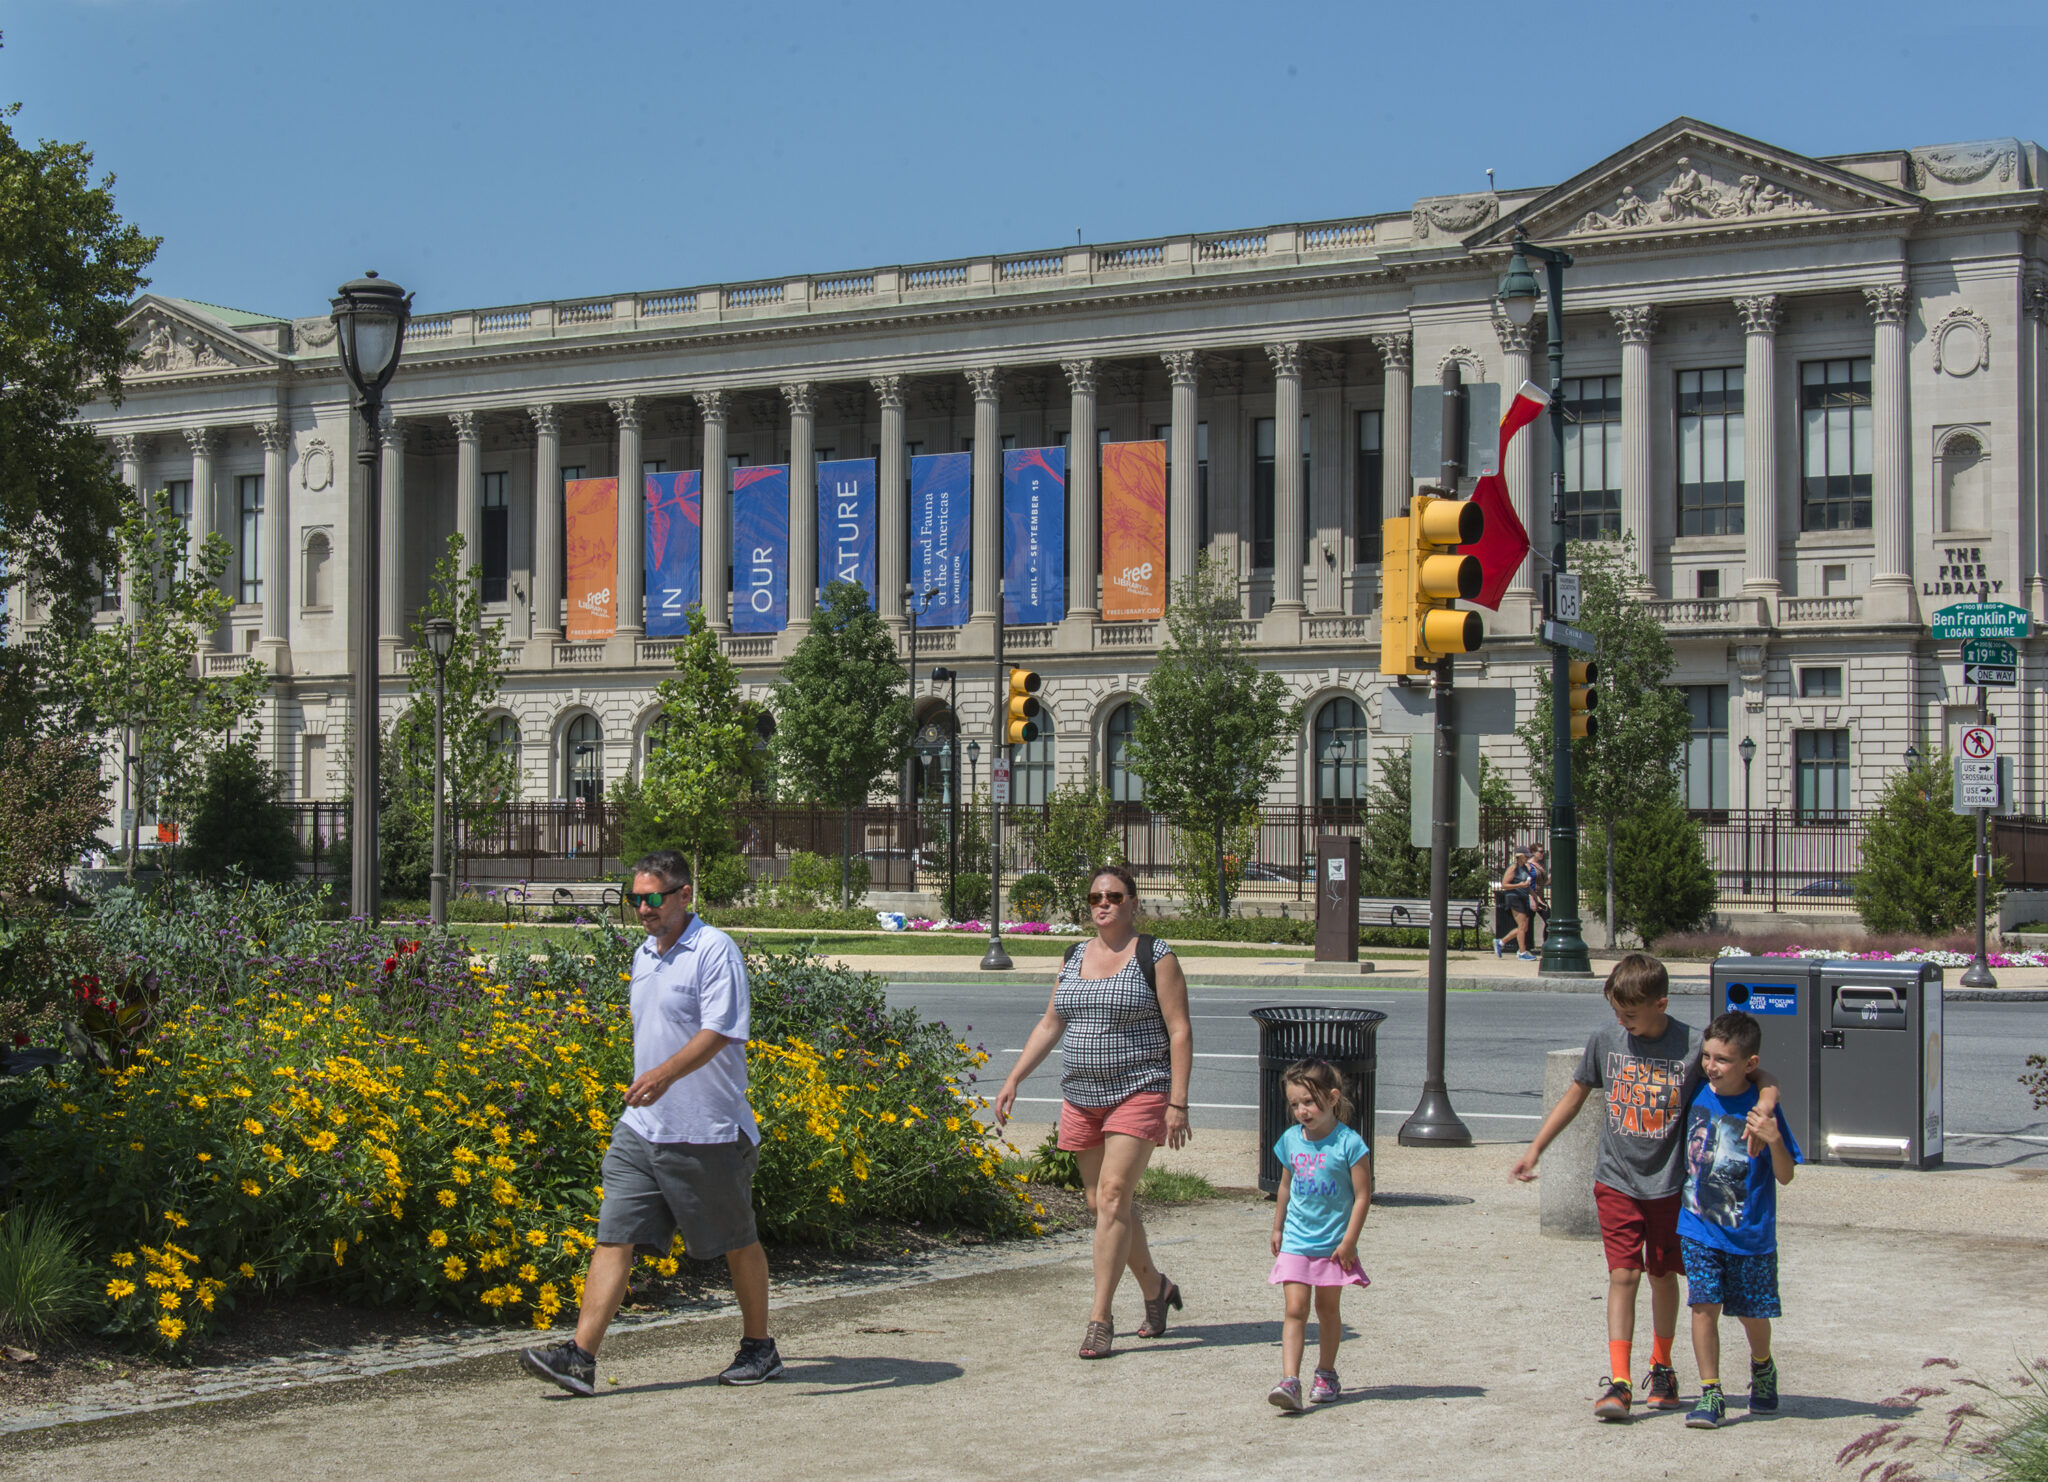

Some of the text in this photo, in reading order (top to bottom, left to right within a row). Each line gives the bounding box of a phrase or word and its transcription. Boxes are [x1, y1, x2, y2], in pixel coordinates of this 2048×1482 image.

[1032, 480, 1040, 491] 15
[837, 479, 859, 584] ATURE
[1031, 495, 1039, 557] SEPTEMBER
[920, 493, 934, 606] Flora and Fauna
[935, 492, 949, 606] of the Americas
[1944, 547, 1981, 564] THE
[751, 546, 773, 613] OUR
[1123, 562, 1153, 582] Free
[1939, 564, 1987, 581] FREE
[1923, 580, 2002, 595] LIBRARY
[587, 588, 610, 606] Free
[662, 588, 682, 617] IN
[1106, 607, 1161, 616] FREELIBRARY.ORG
[1976, 603, 1983, 611] W
[1933, 610, 2027, 626] Ben Franklin Pw
[1565, 628, 1582, 638] CHINA
[1944, 626, 2015, 638] LOGAN SQUARE
[1976, 648, 2014, 664] 19th St
[1977, 670, 2013, 680] ONE WAY
[1606, 1051, 1686, 1086] NEVER
[1604, 1080, 1682, 1108] JUST A
[1606, 1103, 1681, 1139] GAME
[1290, 1153, 1327, 1169] LOVE
[1293, 1179, 1337, 1196] TEAM
